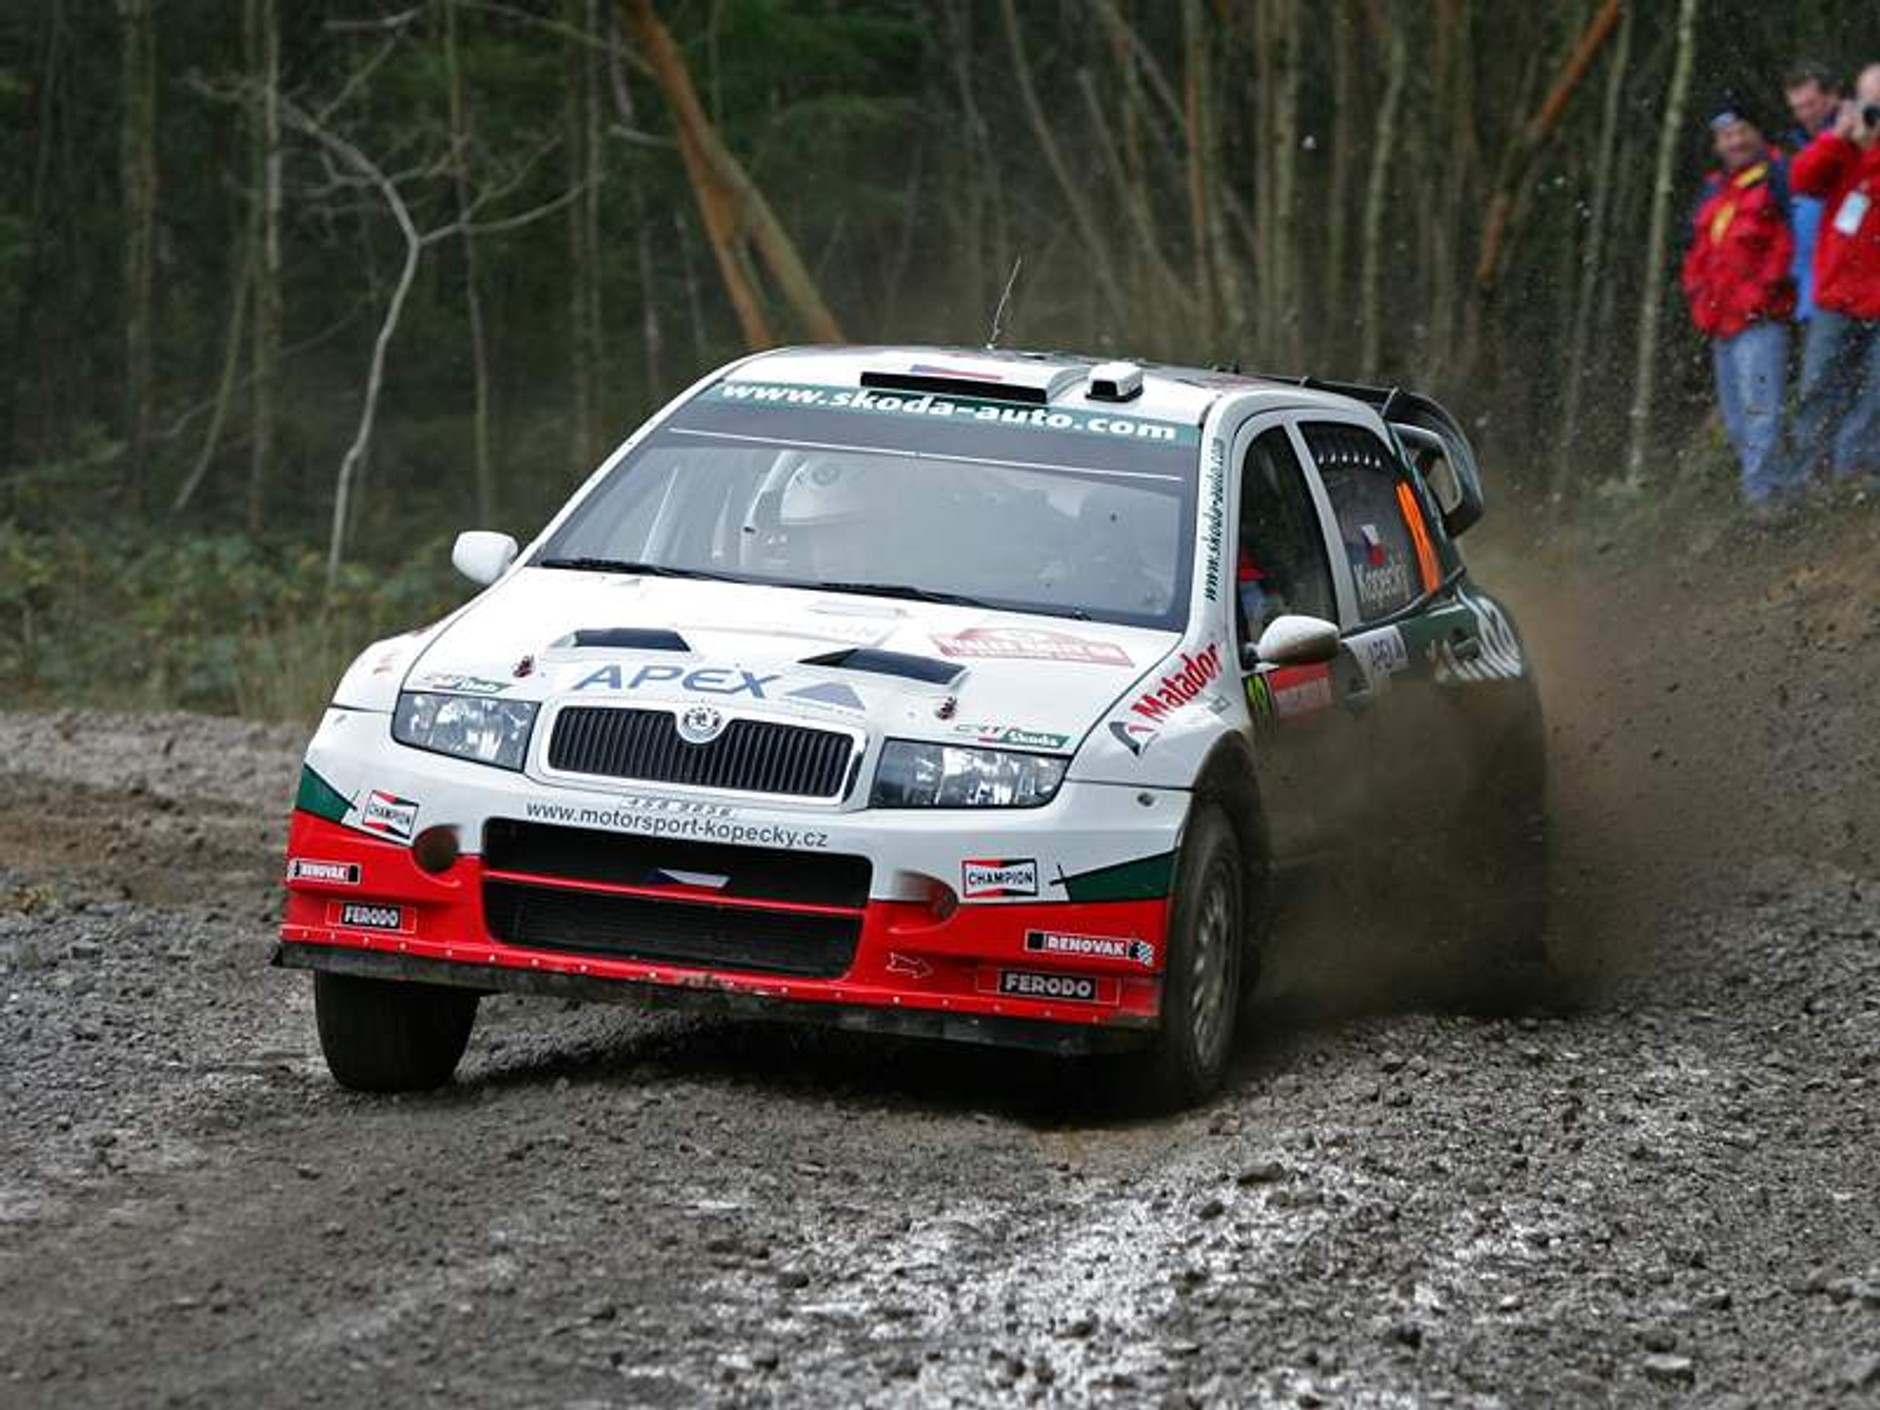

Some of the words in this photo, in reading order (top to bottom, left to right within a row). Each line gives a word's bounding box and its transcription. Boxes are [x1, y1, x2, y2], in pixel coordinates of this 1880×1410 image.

[719, 382, 1176, 441] www.skoda-auto.com
[571, 663, 783, 699] APEX
[1130, 643, 1223, 722] Matador
[525, 800, 829, 848] www.motorsport-kopecky.cz
[967, 870, 1034, 887] CHAMPION
[344, 904, 399, 927] FERODO
[1047, 934, 1125, 957] RENOVAK
[1004, 972, 1093, 997] FERODO
